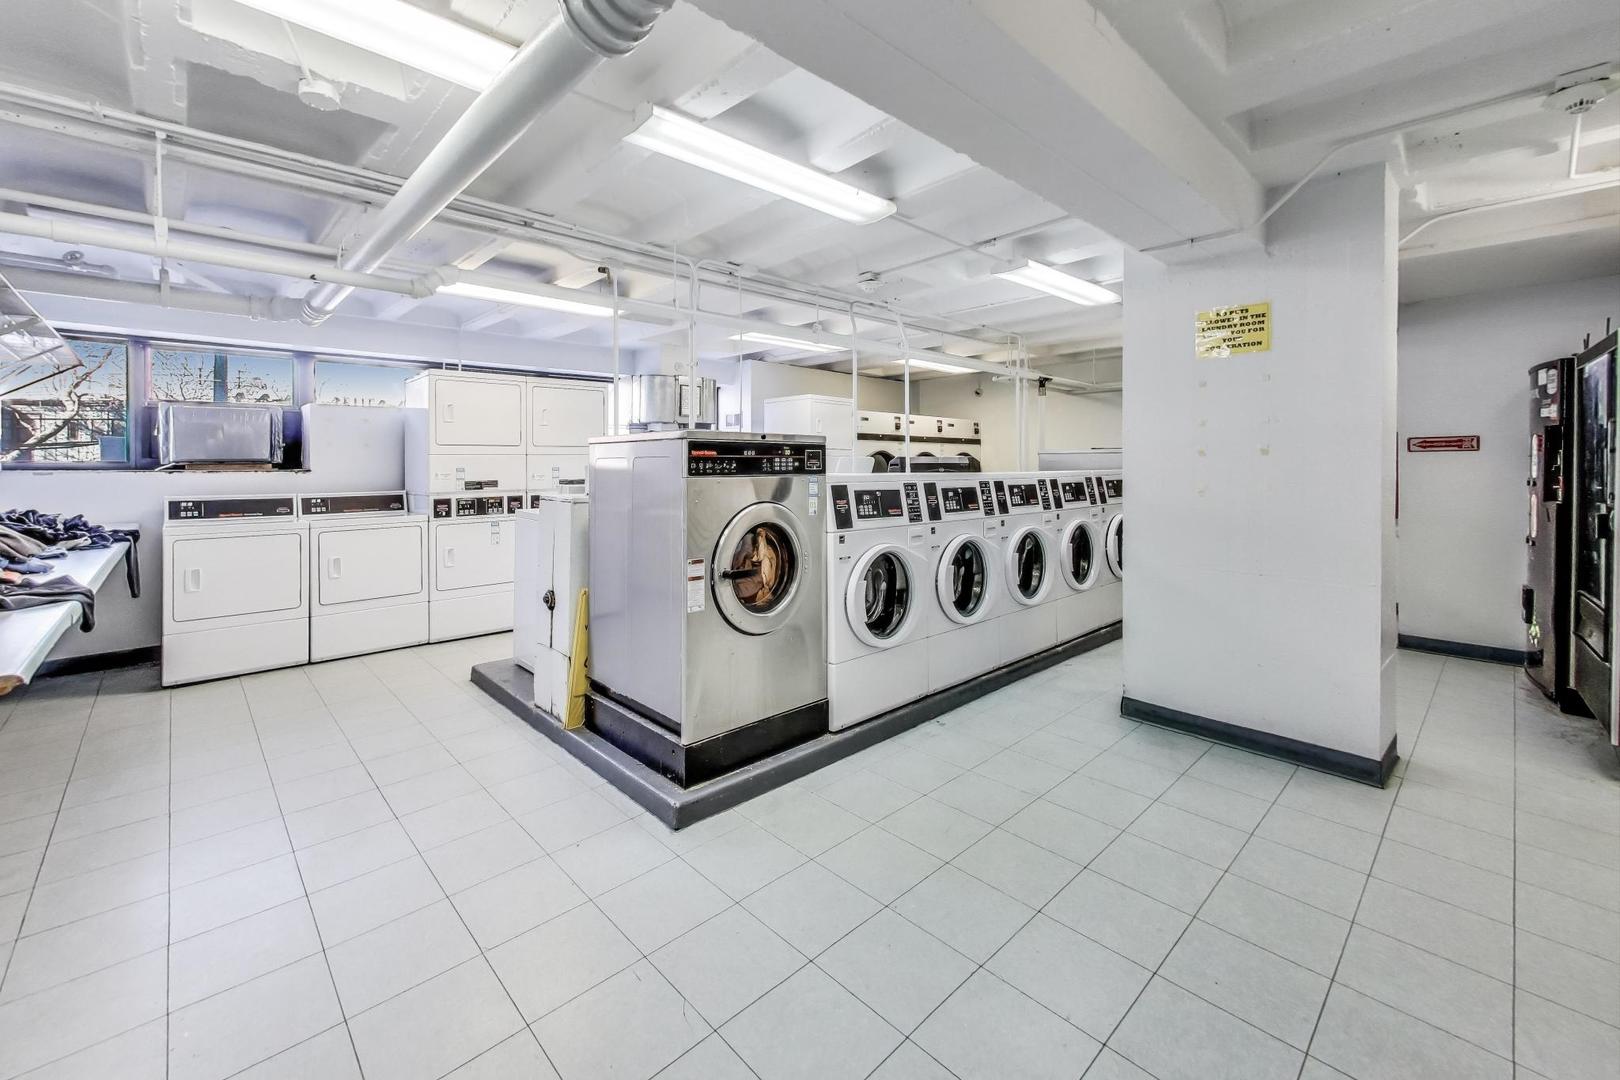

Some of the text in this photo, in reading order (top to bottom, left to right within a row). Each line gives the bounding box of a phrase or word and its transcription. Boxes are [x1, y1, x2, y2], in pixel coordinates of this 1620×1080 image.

[1250, 312, 1267, 320] THE
[1201, 319, 1265, 332] LAUNDRY ROOM
